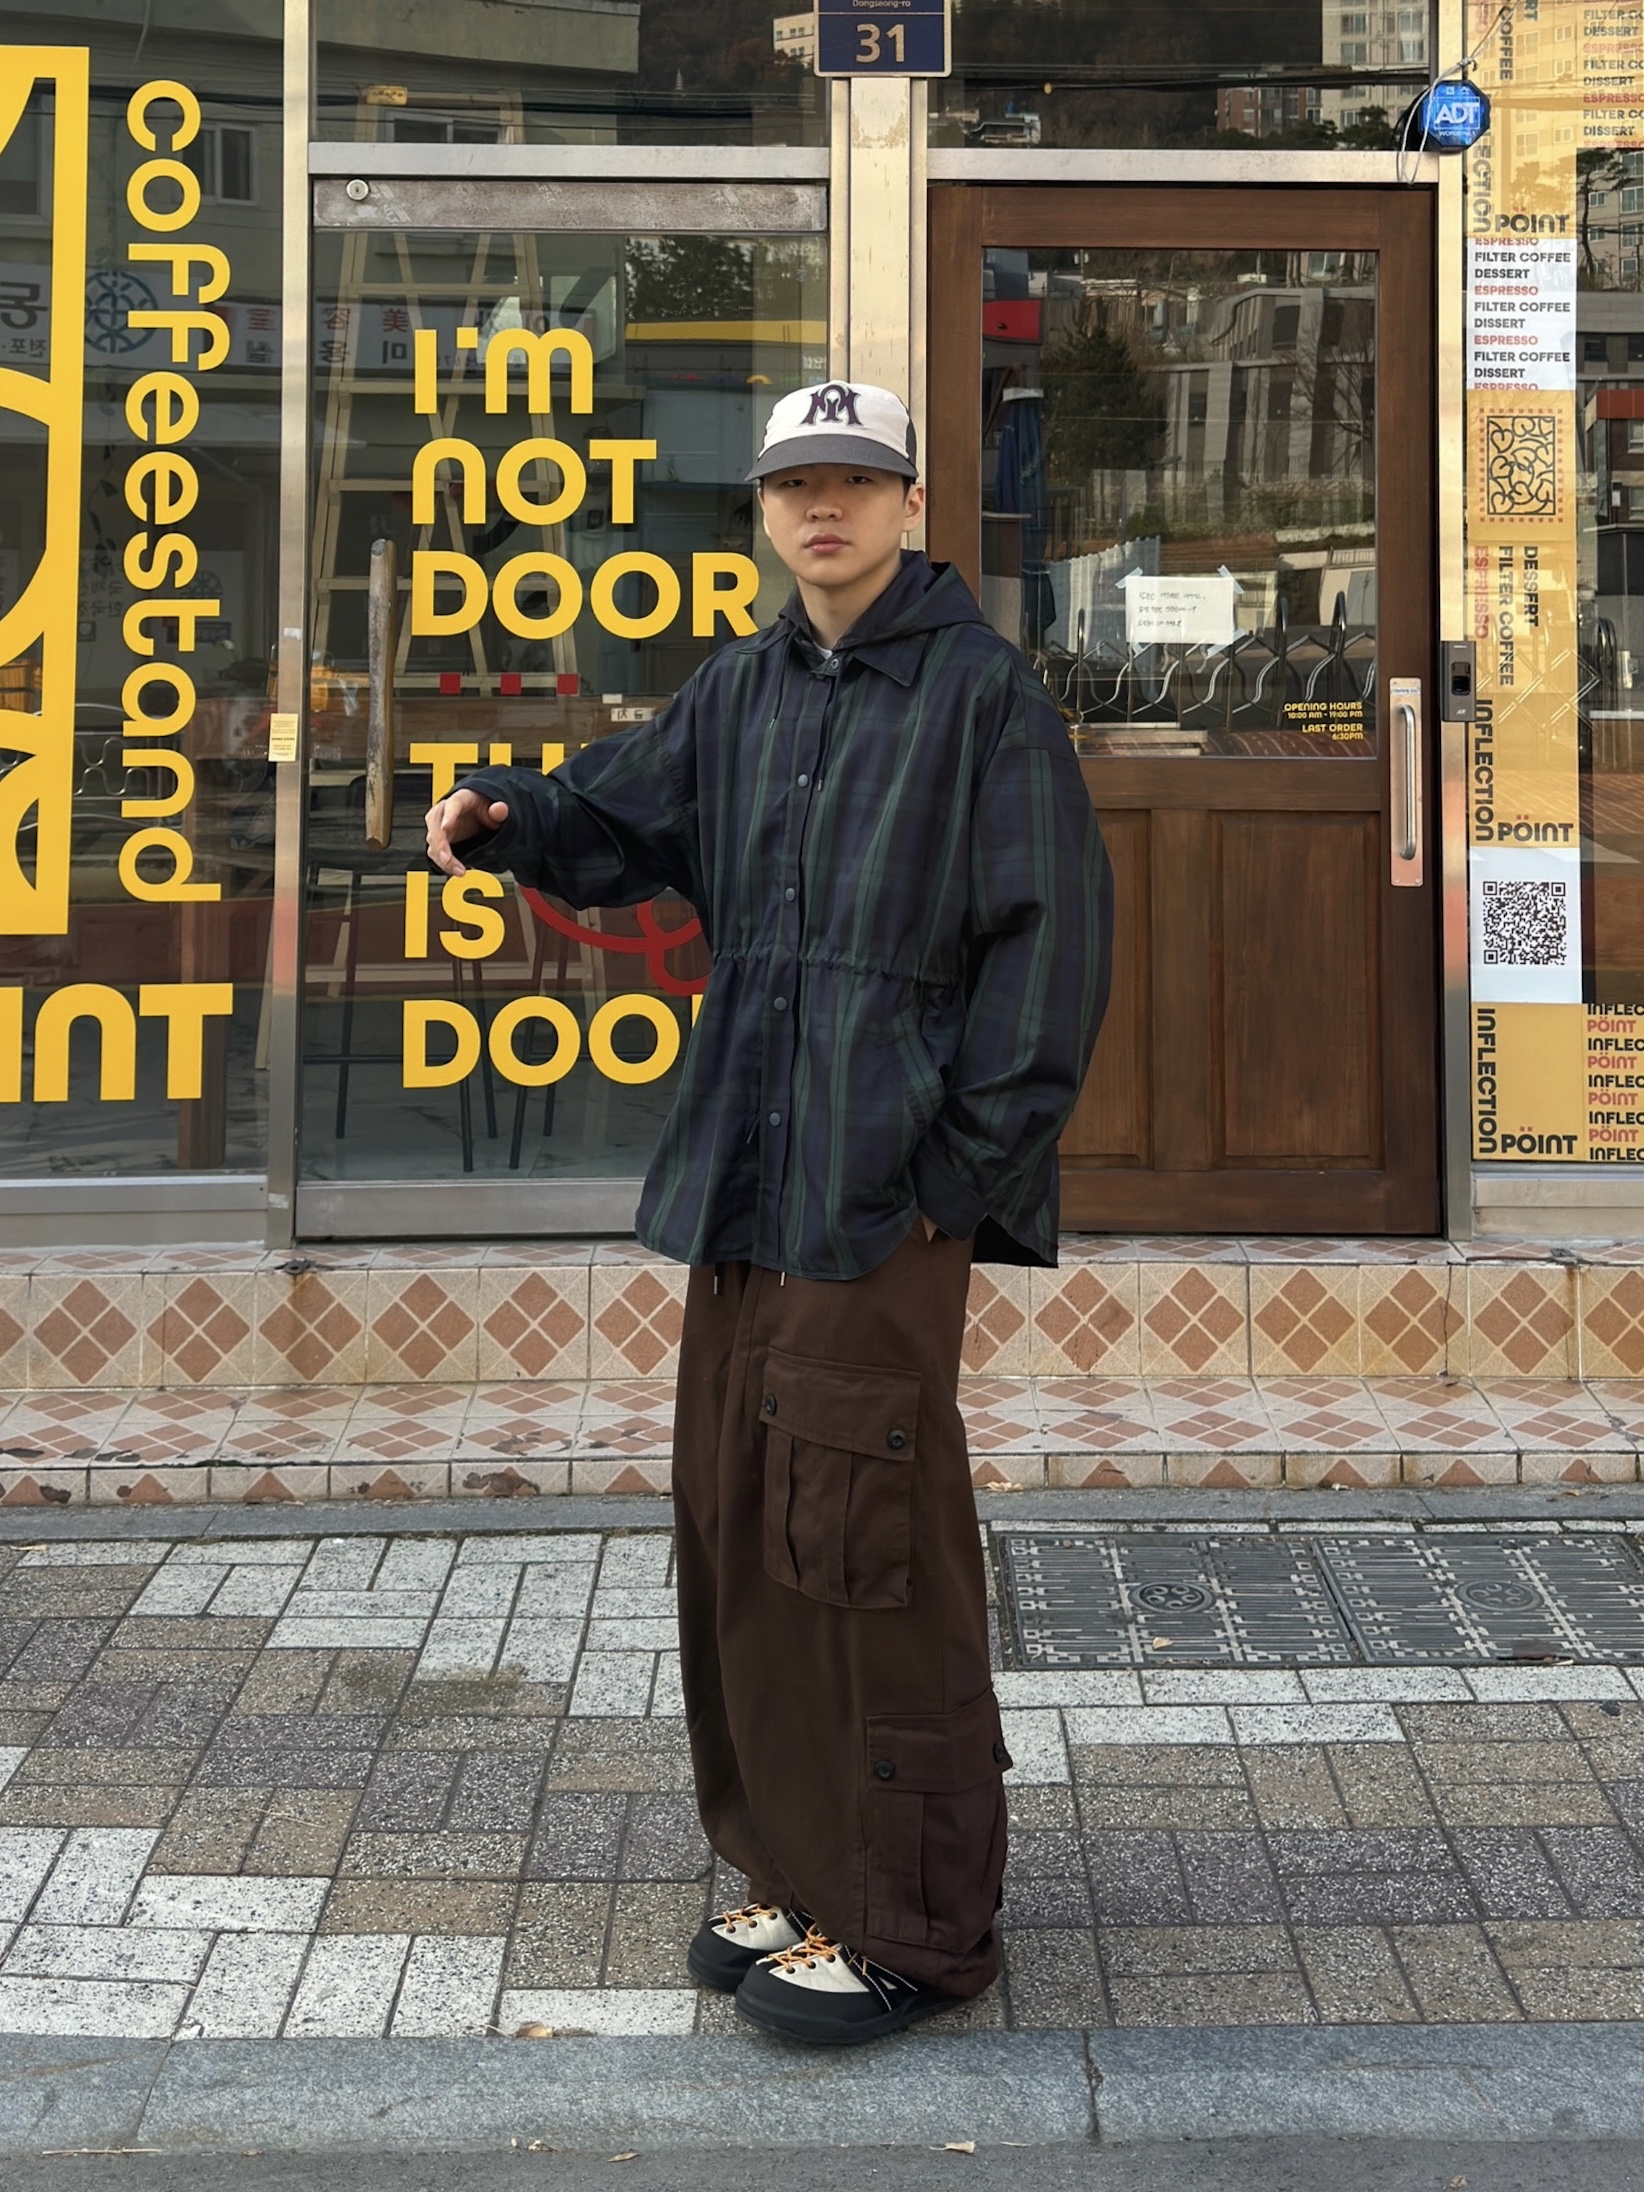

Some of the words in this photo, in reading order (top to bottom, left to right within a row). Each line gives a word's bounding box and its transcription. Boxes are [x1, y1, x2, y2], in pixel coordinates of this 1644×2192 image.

[1583, 9, 1624, 19] FILTER
[1583, 26, 1639, 36] DESSERT
[856, 23, 905, 63] 31
[1500, 6, 1513, 80] COFFEE
[1583, 60, 1624, 70] FILTER
[1583, 76, 1635, 86] DISSERT
[1434, 102, 1479, 124] ADT
[1583, 110, 1624, 120] FILTER
[1583, 126, 1635, 136] DISSERT
[1474, 252, 1516, 262] FILTER
[1519, 252, 1571, 263] COFFEE
[1474, 269, 1530, 279] DESSERT
[1474, 286, 1539, 296] ESPRESSO
[1474, 302, 1516, 312] FILTER
[1519, 302, 1571, 312] COFFEE
[1474, 318, 1526, 328] DISSERT
[1474, 335, 1539, 345] ESPRESSO
[1474, 351, 1516, 362] FILTER
[1519, 352, 1570, 362] COFFEE
[1474, 368, 1526, 378] DISSERT
[118, 80, 231, 904] coffeestand
[1499, 546, 1514, 606] FILTER
[1523, 546, 1539, 627] DESSERT
[411, 551, 760, 640] DOOR
[1499, 611, 1514, 686] COFFEE
[1284, 702, 1328, 711] OPENING
[1329, 702, 1363, 710] HOURS
[1349, 710, 1363, 718] PM
[1302, 724, 1327, 733] LAST
[1328, 723, 1364, 732] ORDER
[404, 869, 505, 959] IS
[402, 993, 704, 1088] DOO
